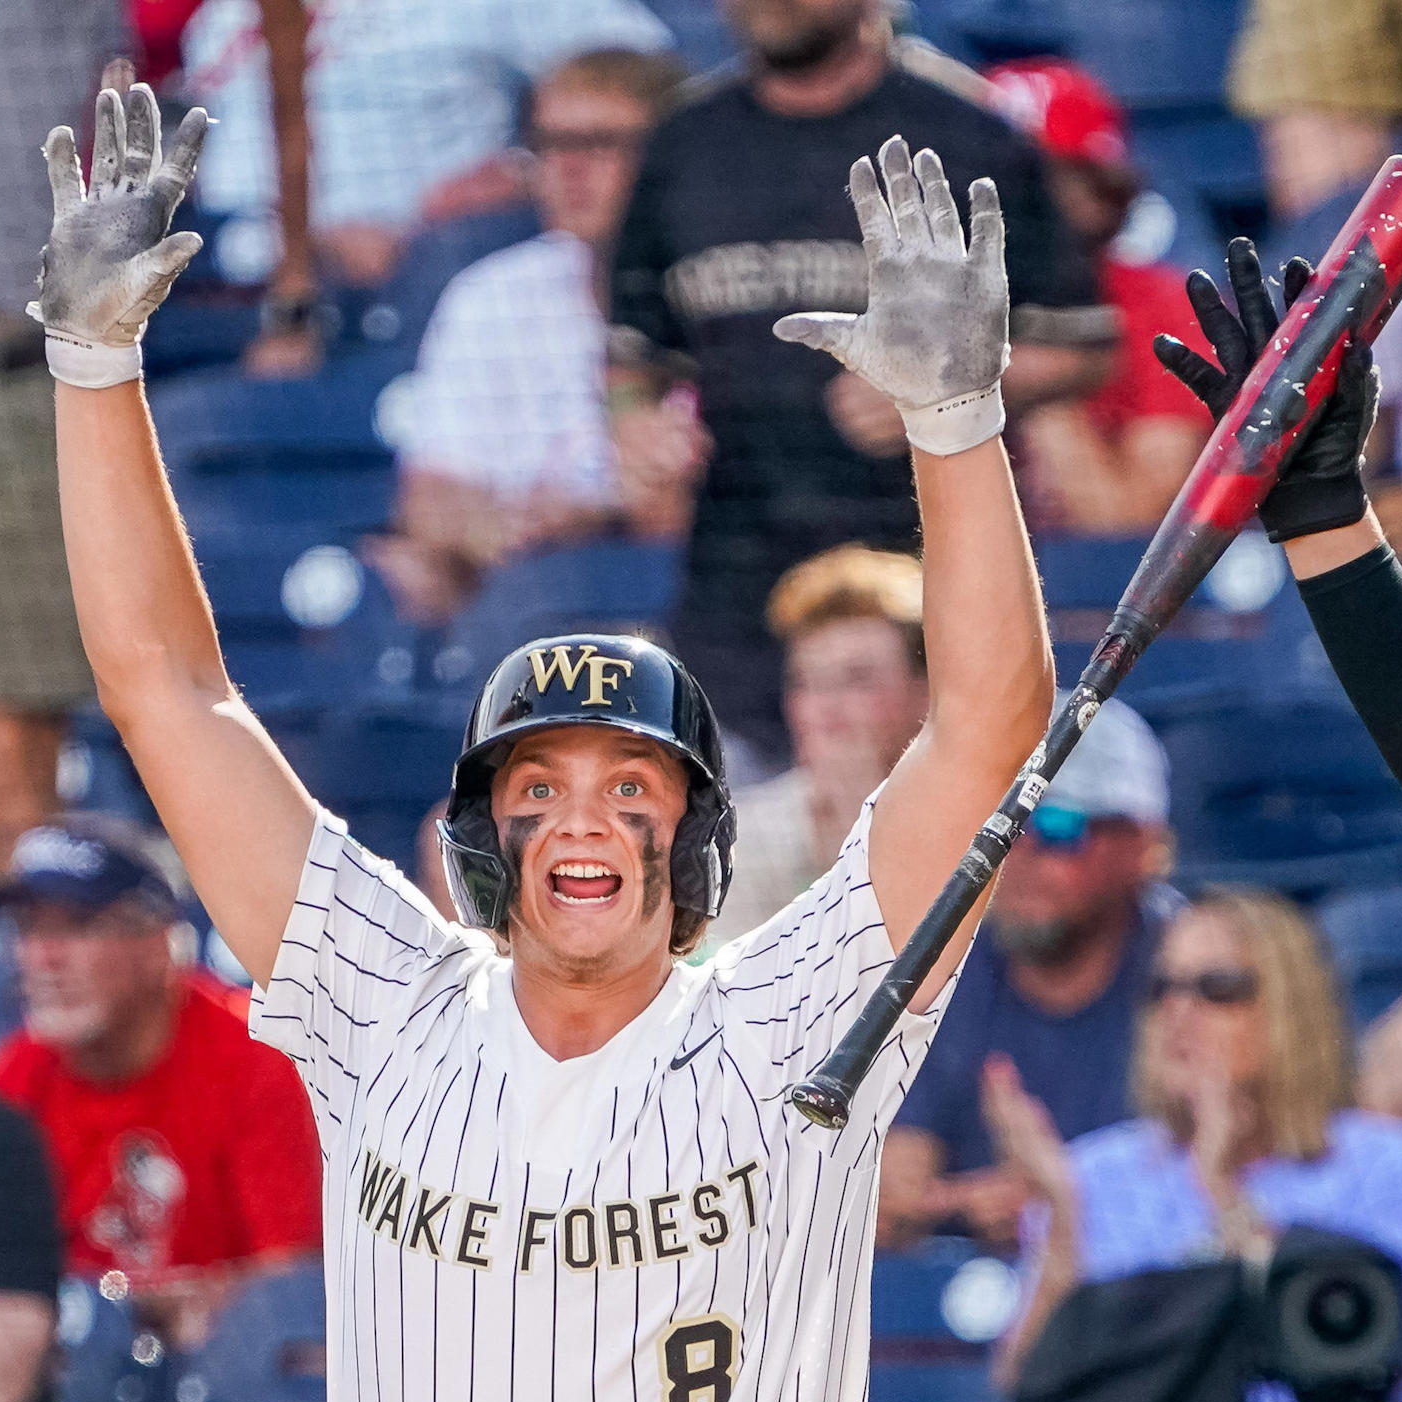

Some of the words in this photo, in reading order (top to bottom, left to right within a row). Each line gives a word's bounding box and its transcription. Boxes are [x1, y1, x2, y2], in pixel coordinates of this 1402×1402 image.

[526, 644, 634, 706] WF
[356, 1147, 502, 1272] WAKE
[518, 1157, 764, 1275] FOREST
